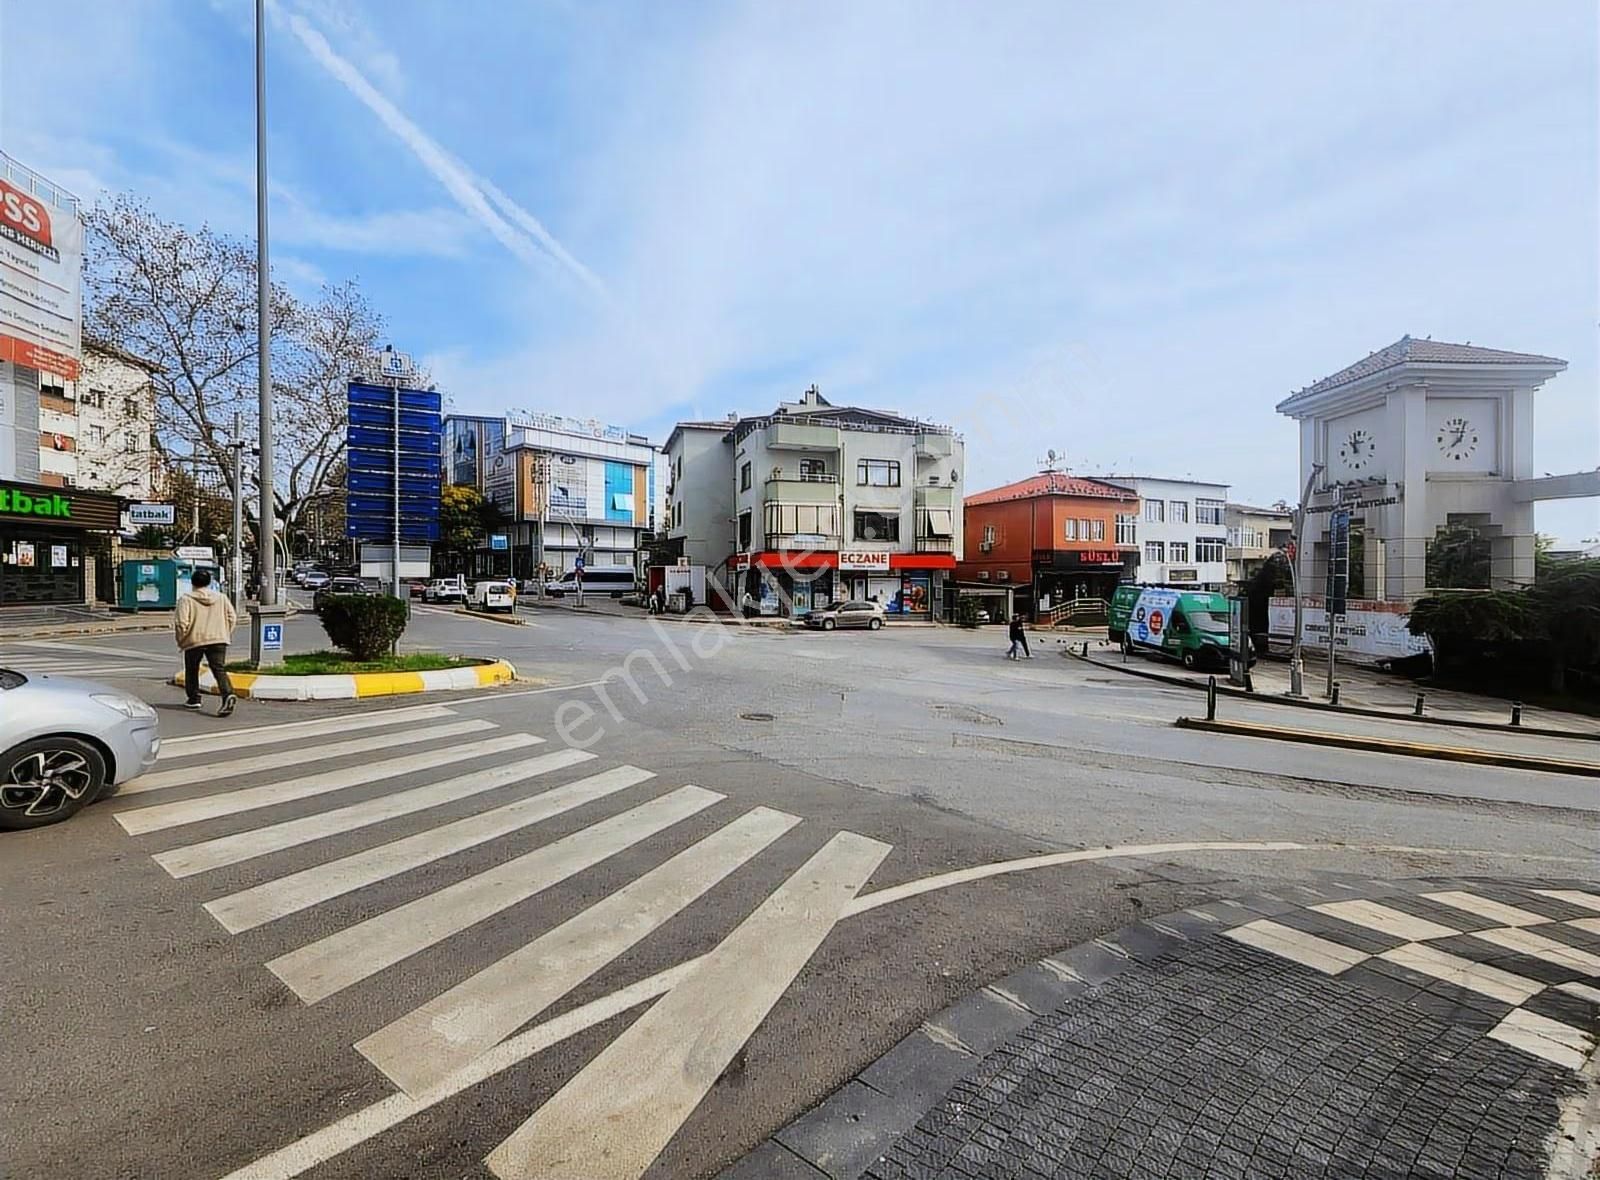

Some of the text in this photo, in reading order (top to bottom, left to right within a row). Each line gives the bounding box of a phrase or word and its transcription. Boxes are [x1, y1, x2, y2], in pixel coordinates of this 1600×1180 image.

[0, 188, 41, 232] SS
[131, 509, 169, 519] tatbak
[840, 553, 888, 564] ECZANE
